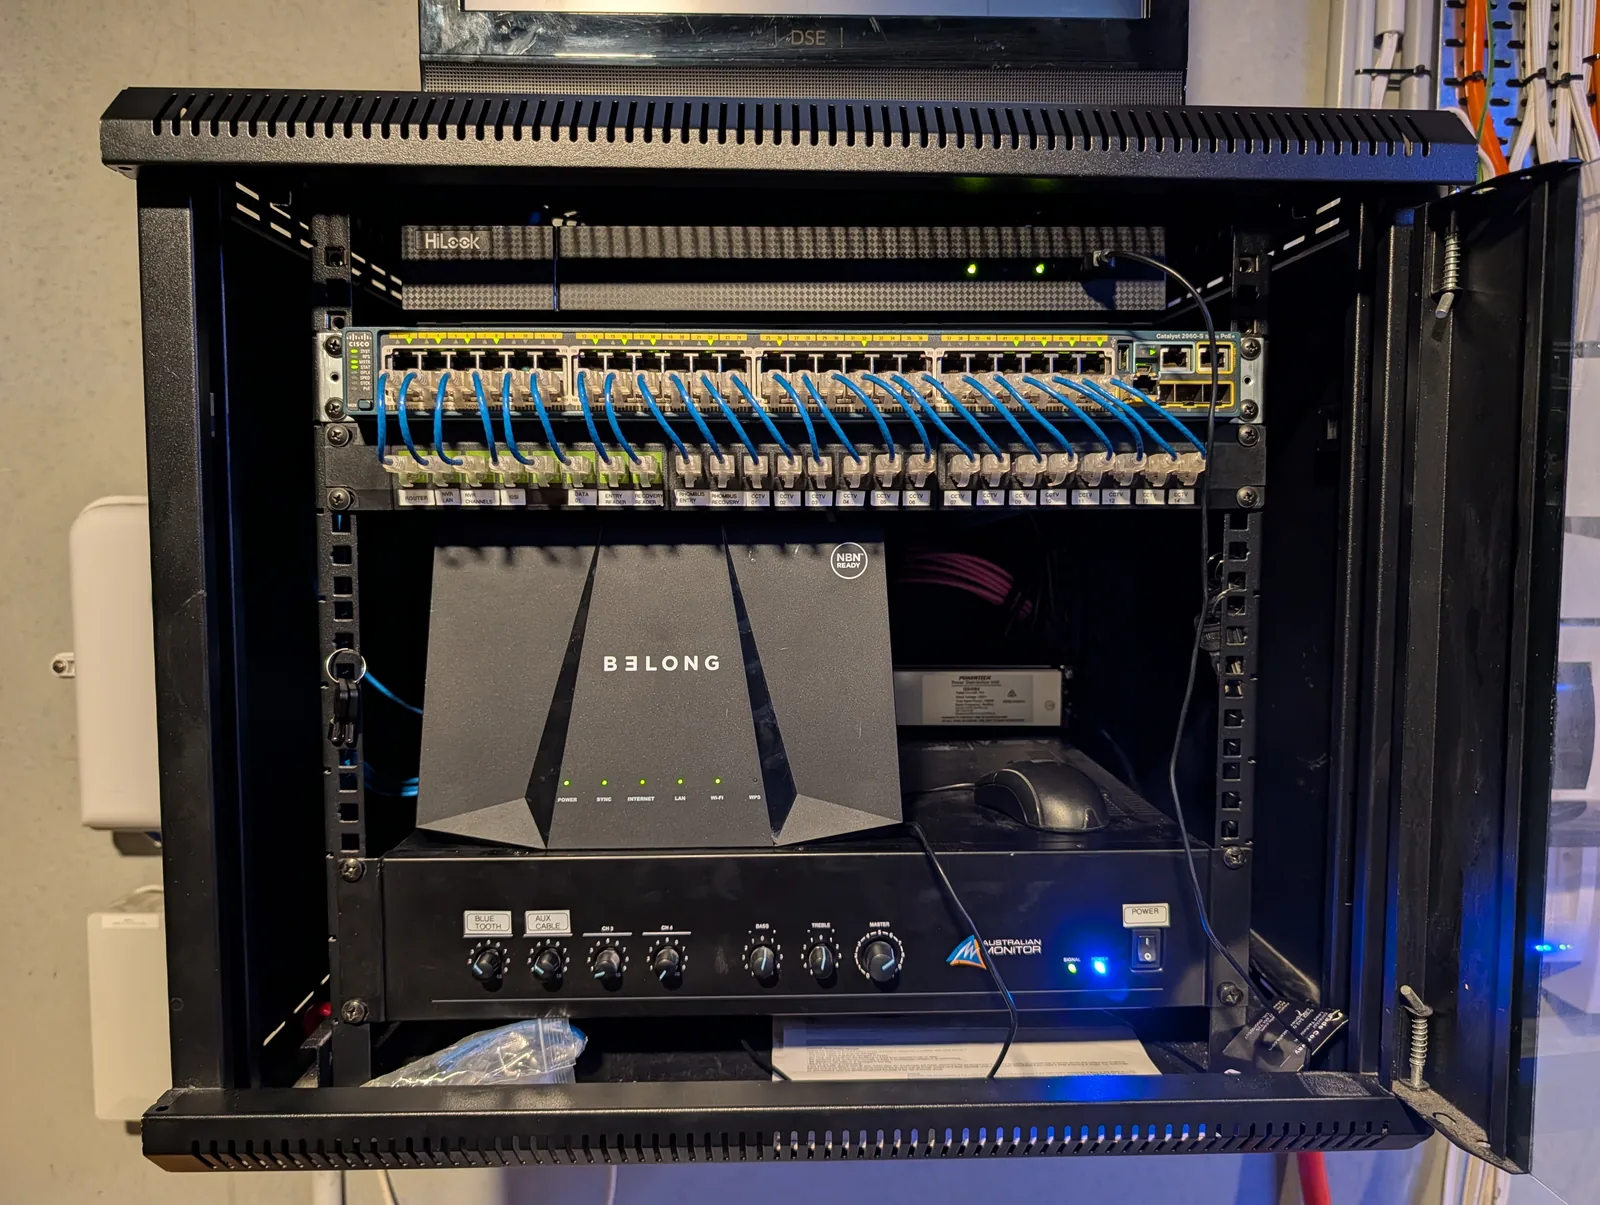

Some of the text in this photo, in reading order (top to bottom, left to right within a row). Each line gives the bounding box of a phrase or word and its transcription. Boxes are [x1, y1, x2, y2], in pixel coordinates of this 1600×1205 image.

[791, 29, 826, 46] DSE
[425, 233, 480, 249] HiLook
[1131, 907, 1160, 916] POWER
